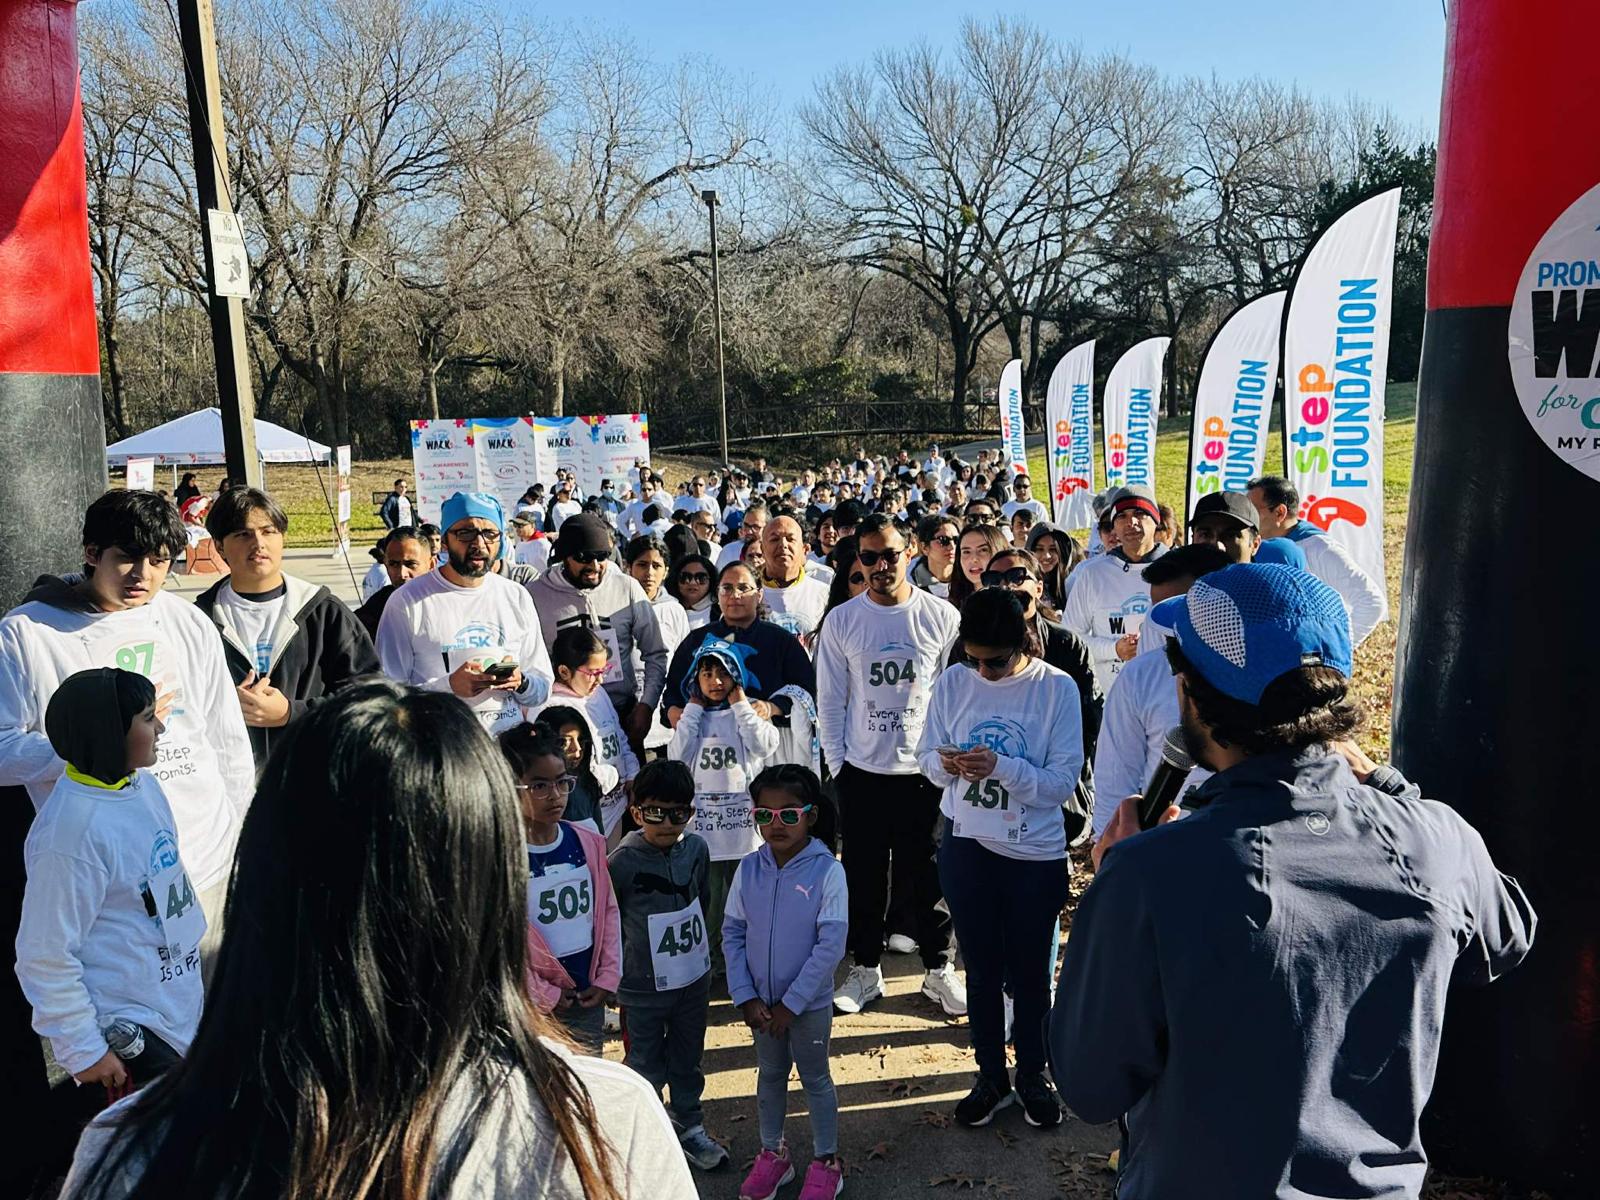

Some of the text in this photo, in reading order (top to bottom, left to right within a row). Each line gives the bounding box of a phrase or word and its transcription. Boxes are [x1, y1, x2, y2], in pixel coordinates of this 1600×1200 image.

[1331, 278, 1378, 487] FOUNDATION
[1537, 385, 1582, 418] for
[1009, 388, 1024, 461] FOUNDATION
[1072, 384, 1090, 474] FOUNDATION
[1223, 360, 1268, 494] OUNDATION
[1291, 363, 1334, 474] step
[426, 440, 451, 450] WALK
[488, 438, 513, 449] WALK
[547, 437, 571, 448] WALK
[605, 435, 627, 445] WALK
[1055, 420, 1072, 468] step
[1557, 437, 1587, 449] MY
[1196, 416, 1230, 494] step
[468, 636, 492, 648] 5K
[116, 641, 155, 677] 97
[869, 659, 917, 687] 504
[868, 720, 876, 732] Is
[879, 723, 887, 732] a
[869, 711, 899, 721] Every
[984, 733, 1009, 754] 5K
[157, 747, 191, 763] Step
[699, 746, 738, 770] 538
[696, 807, 749, 821] Every Step
[695, 820, 703, 831] Is
[706, 823, 714, 831] a
[537, 879, 591, 924] 505
[656, 914, 703, 958] 450
[160, 965, 172, 983] Is
[175, 964, 183, 977] a
